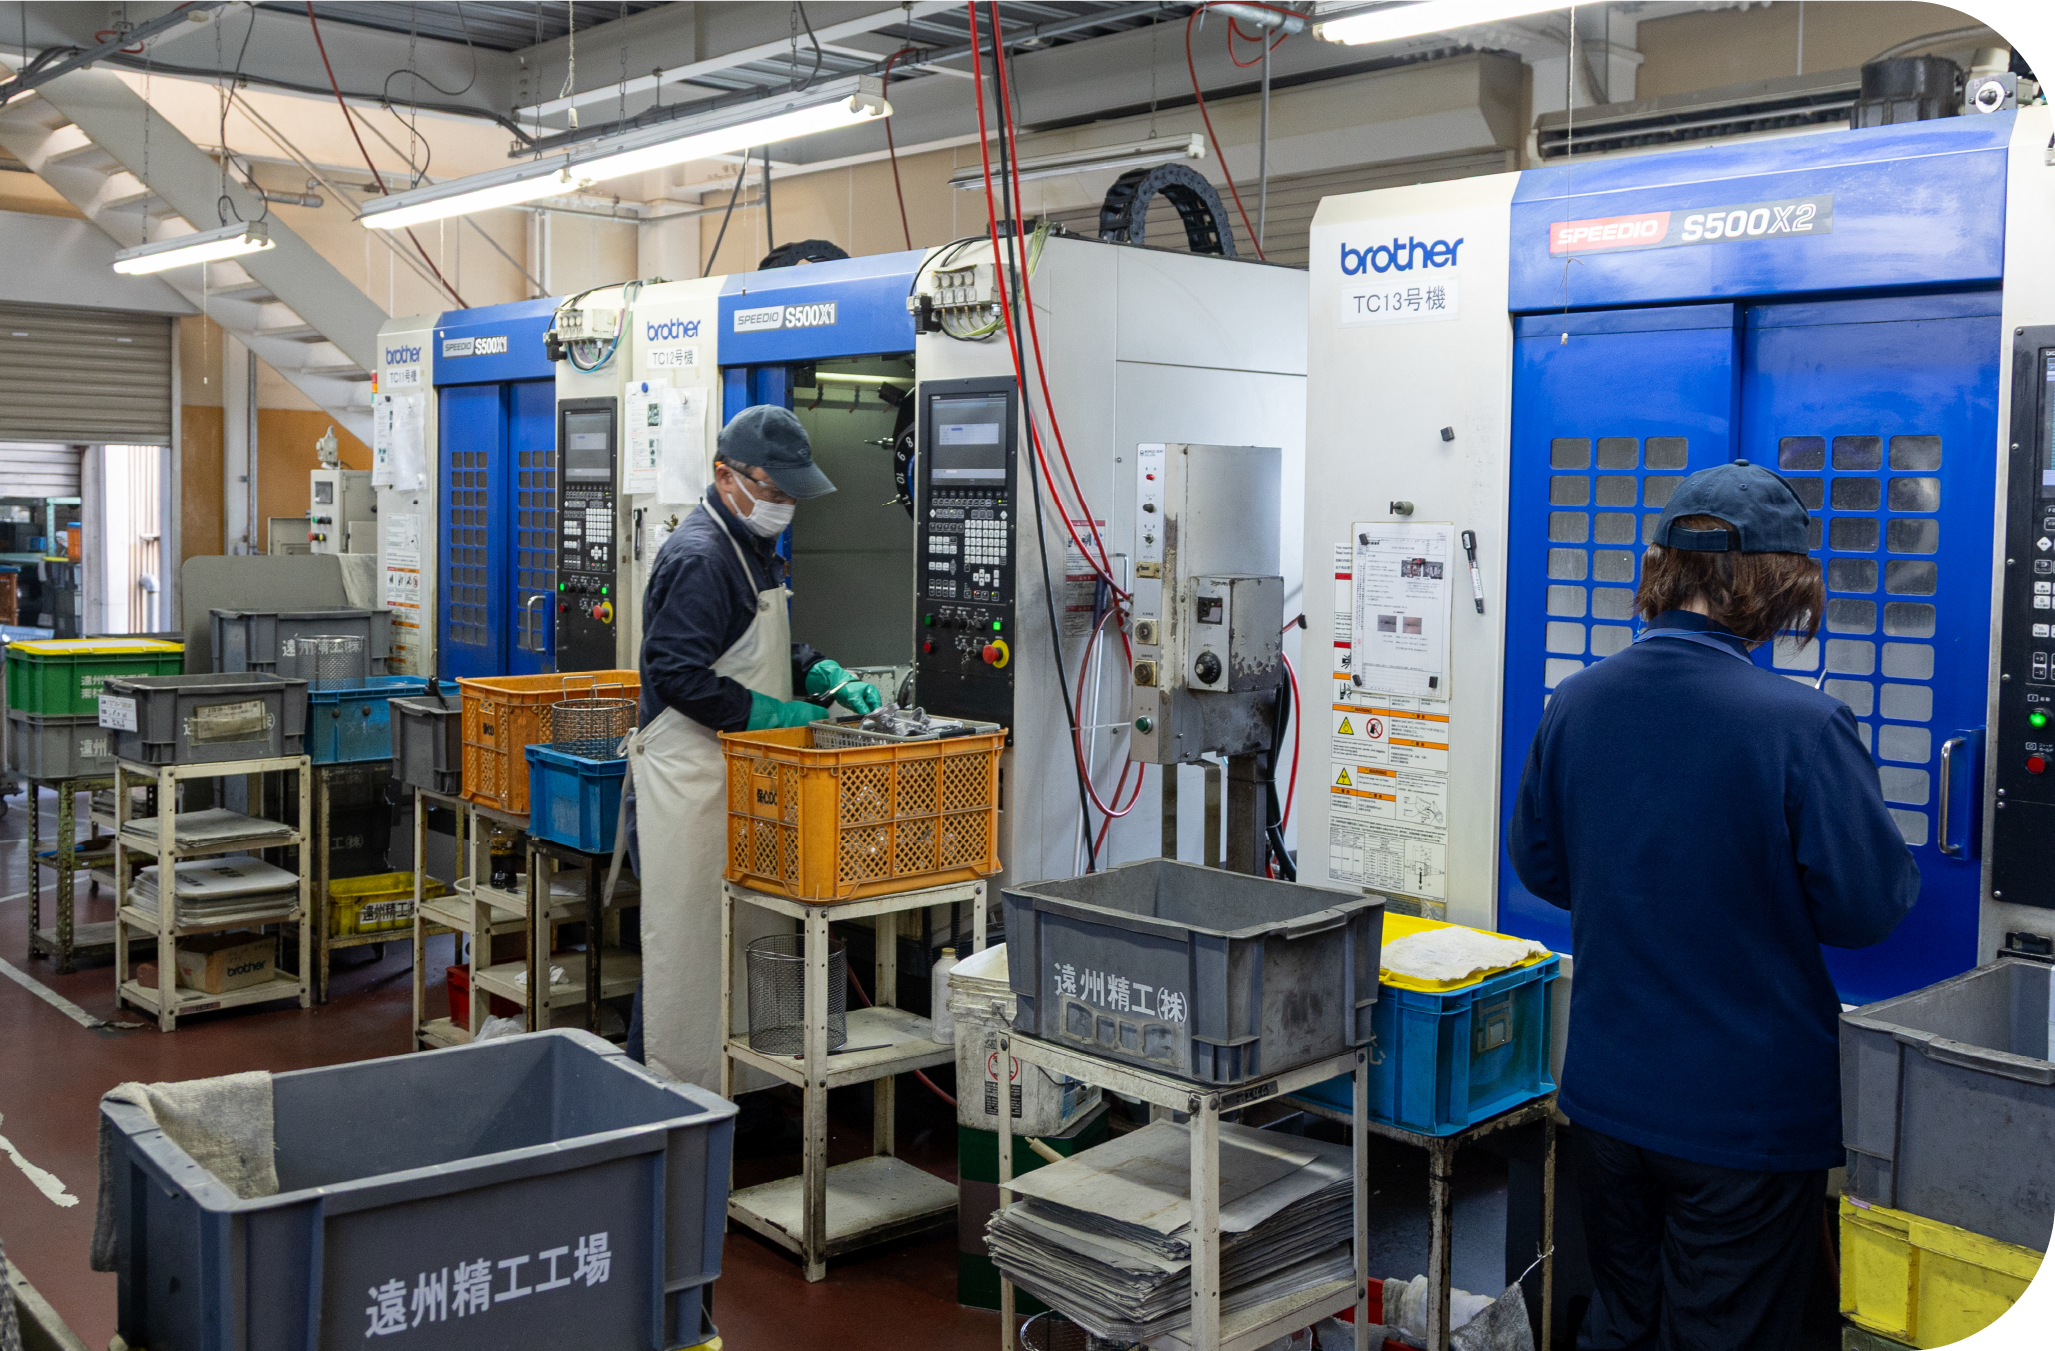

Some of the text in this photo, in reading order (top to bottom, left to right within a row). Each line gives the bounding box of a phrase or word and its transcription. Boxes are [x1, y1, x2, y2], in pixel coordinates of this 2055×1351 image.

[1557, 203, 1817, 245] SPEEDIO S500X2
[1340, 236, 1465, 276] brother
[1353, 285, 1447, 315] TC13号機
[737, 302, 836, 329] SPEEDIO S500X1
[646, 317, 702, 342] brother
[385, 344, 422, 366] brother
[444, 335, 508, 355] SPEEDIO S500X1
[651, 348, 694, 366] TC12号機
[80, 738, 111, 758] 遠州
[226, 960, 267, 977] brother
[1053, 962, 1188, 1023] 遠州精工(株)
[364, 1231, 612, 1338] 遠州精工工場
